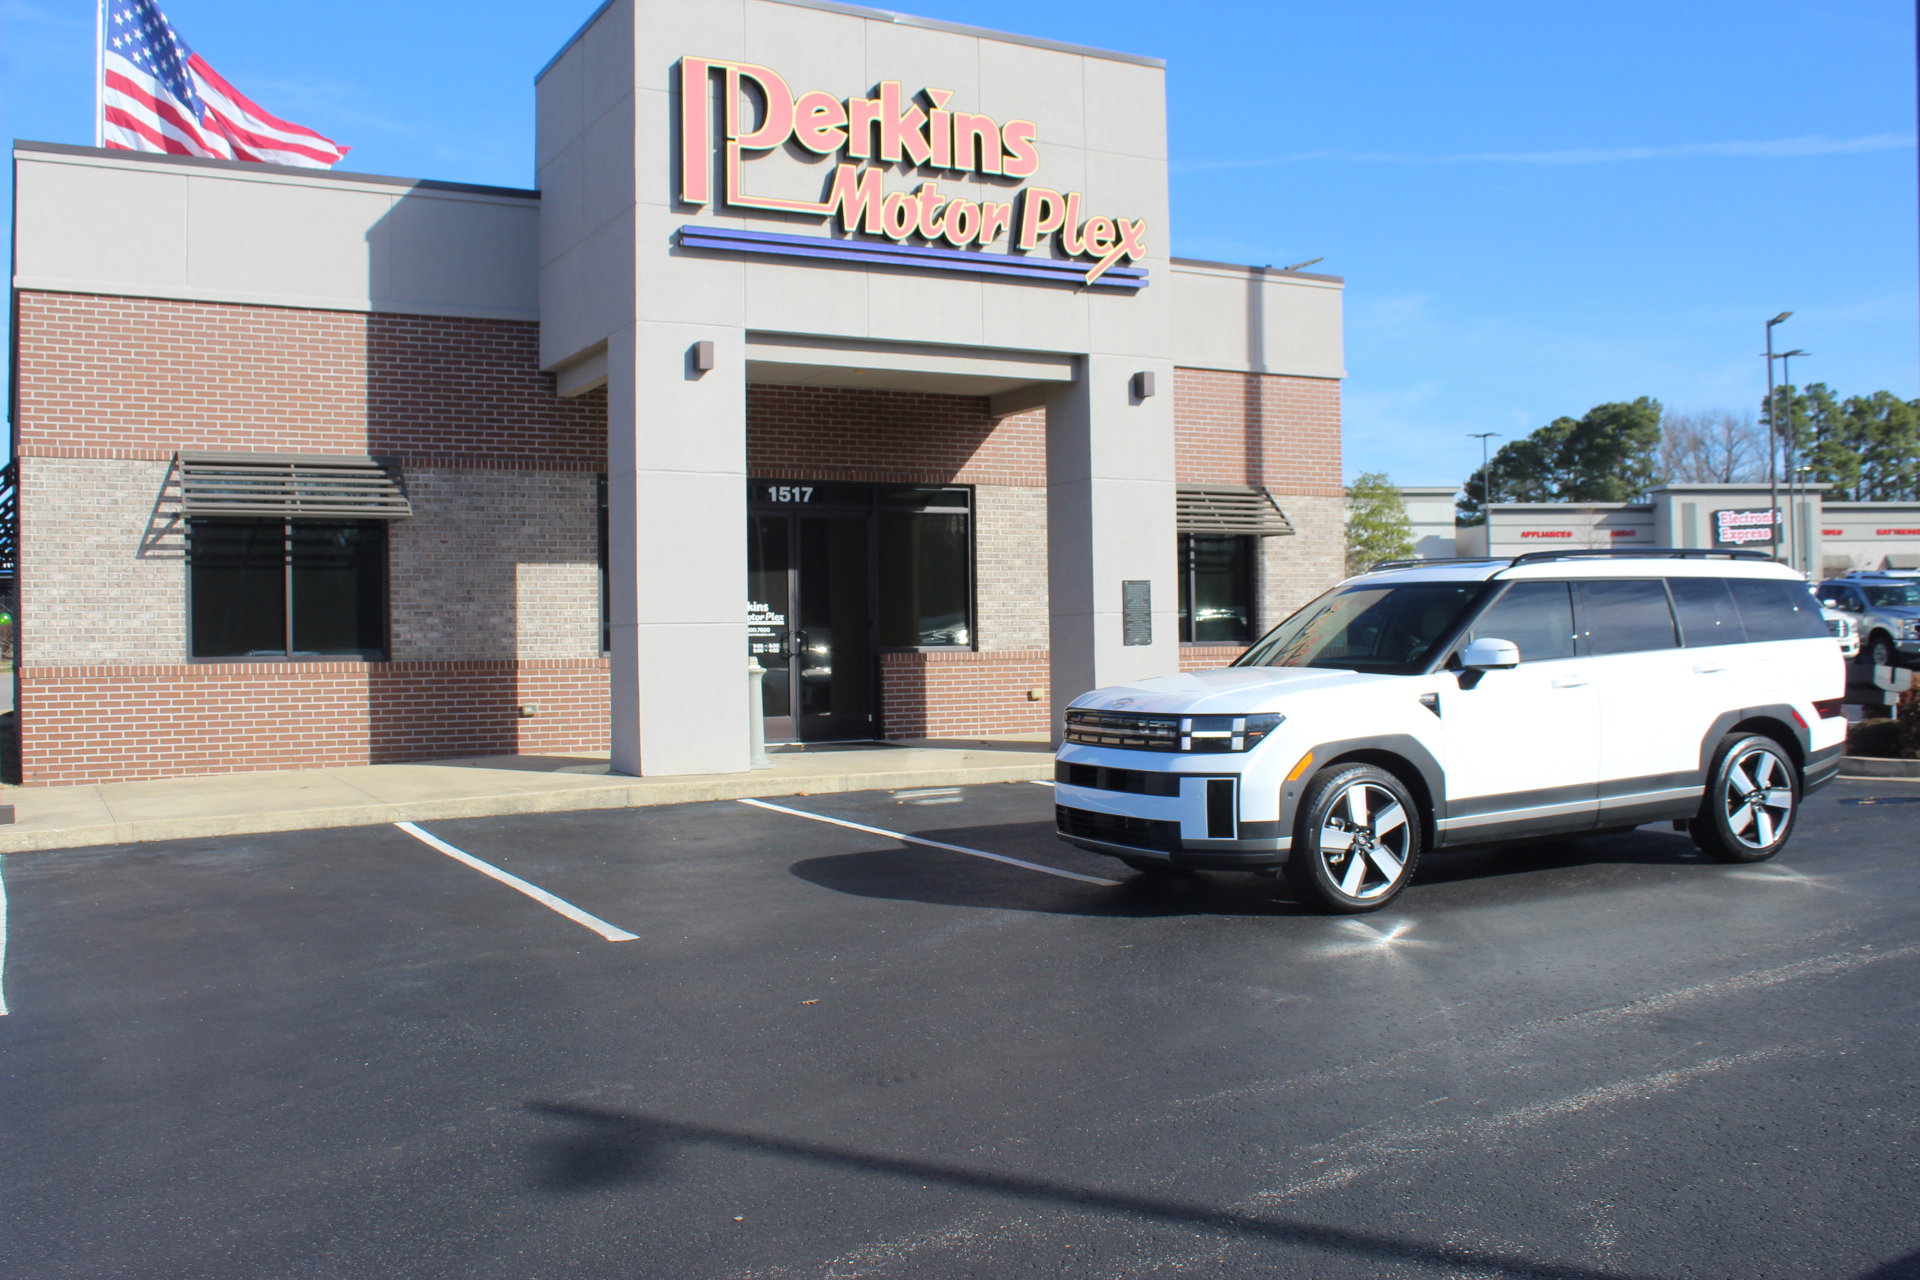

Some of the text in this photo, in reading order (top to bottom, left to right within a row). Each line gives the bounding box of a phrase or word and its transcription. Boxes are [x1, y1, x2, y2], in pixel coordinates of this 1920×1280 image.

[682, 55, 1041, 215] Perkins
[831, 163, 1148, 286] Motor Plex
[768, 486, 814, 503] 1517
[1520, 530, 1574, 538] APPLIANCES
[1718, 526, 1773, 545] Express
[747, 601, 769, 612] kins
